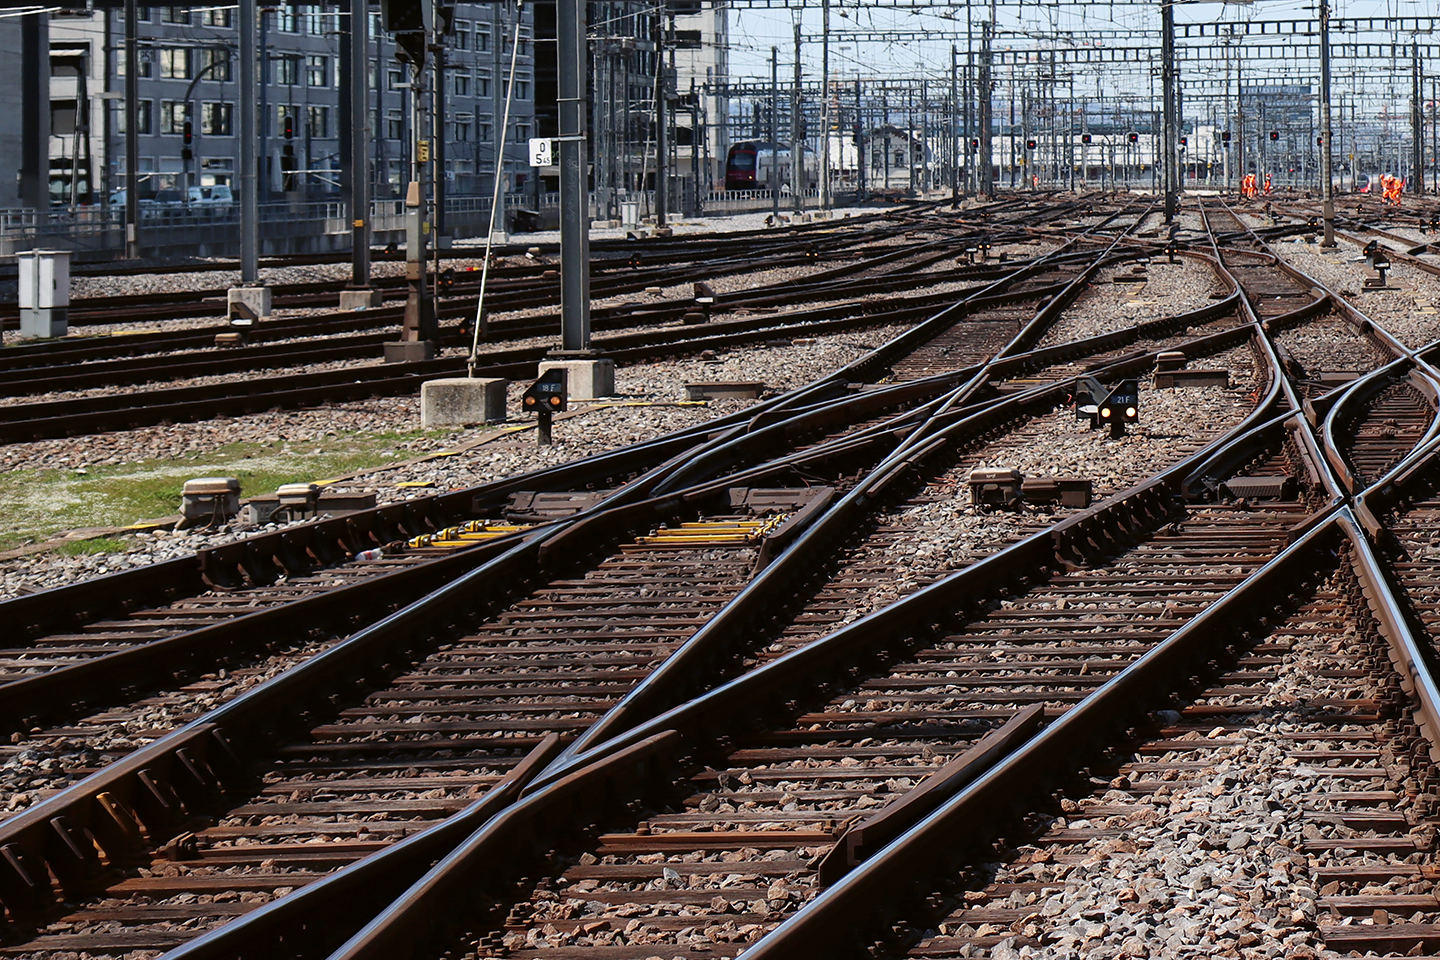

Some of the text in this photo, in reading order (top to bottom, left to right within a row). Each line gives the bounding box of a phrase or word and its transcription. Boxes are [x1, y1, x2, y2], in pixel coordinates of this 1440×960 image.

[539, 142, 546, 153] 0
[542, 384, 549, 392] 18
[1116, 396, 1125, 404] 21
